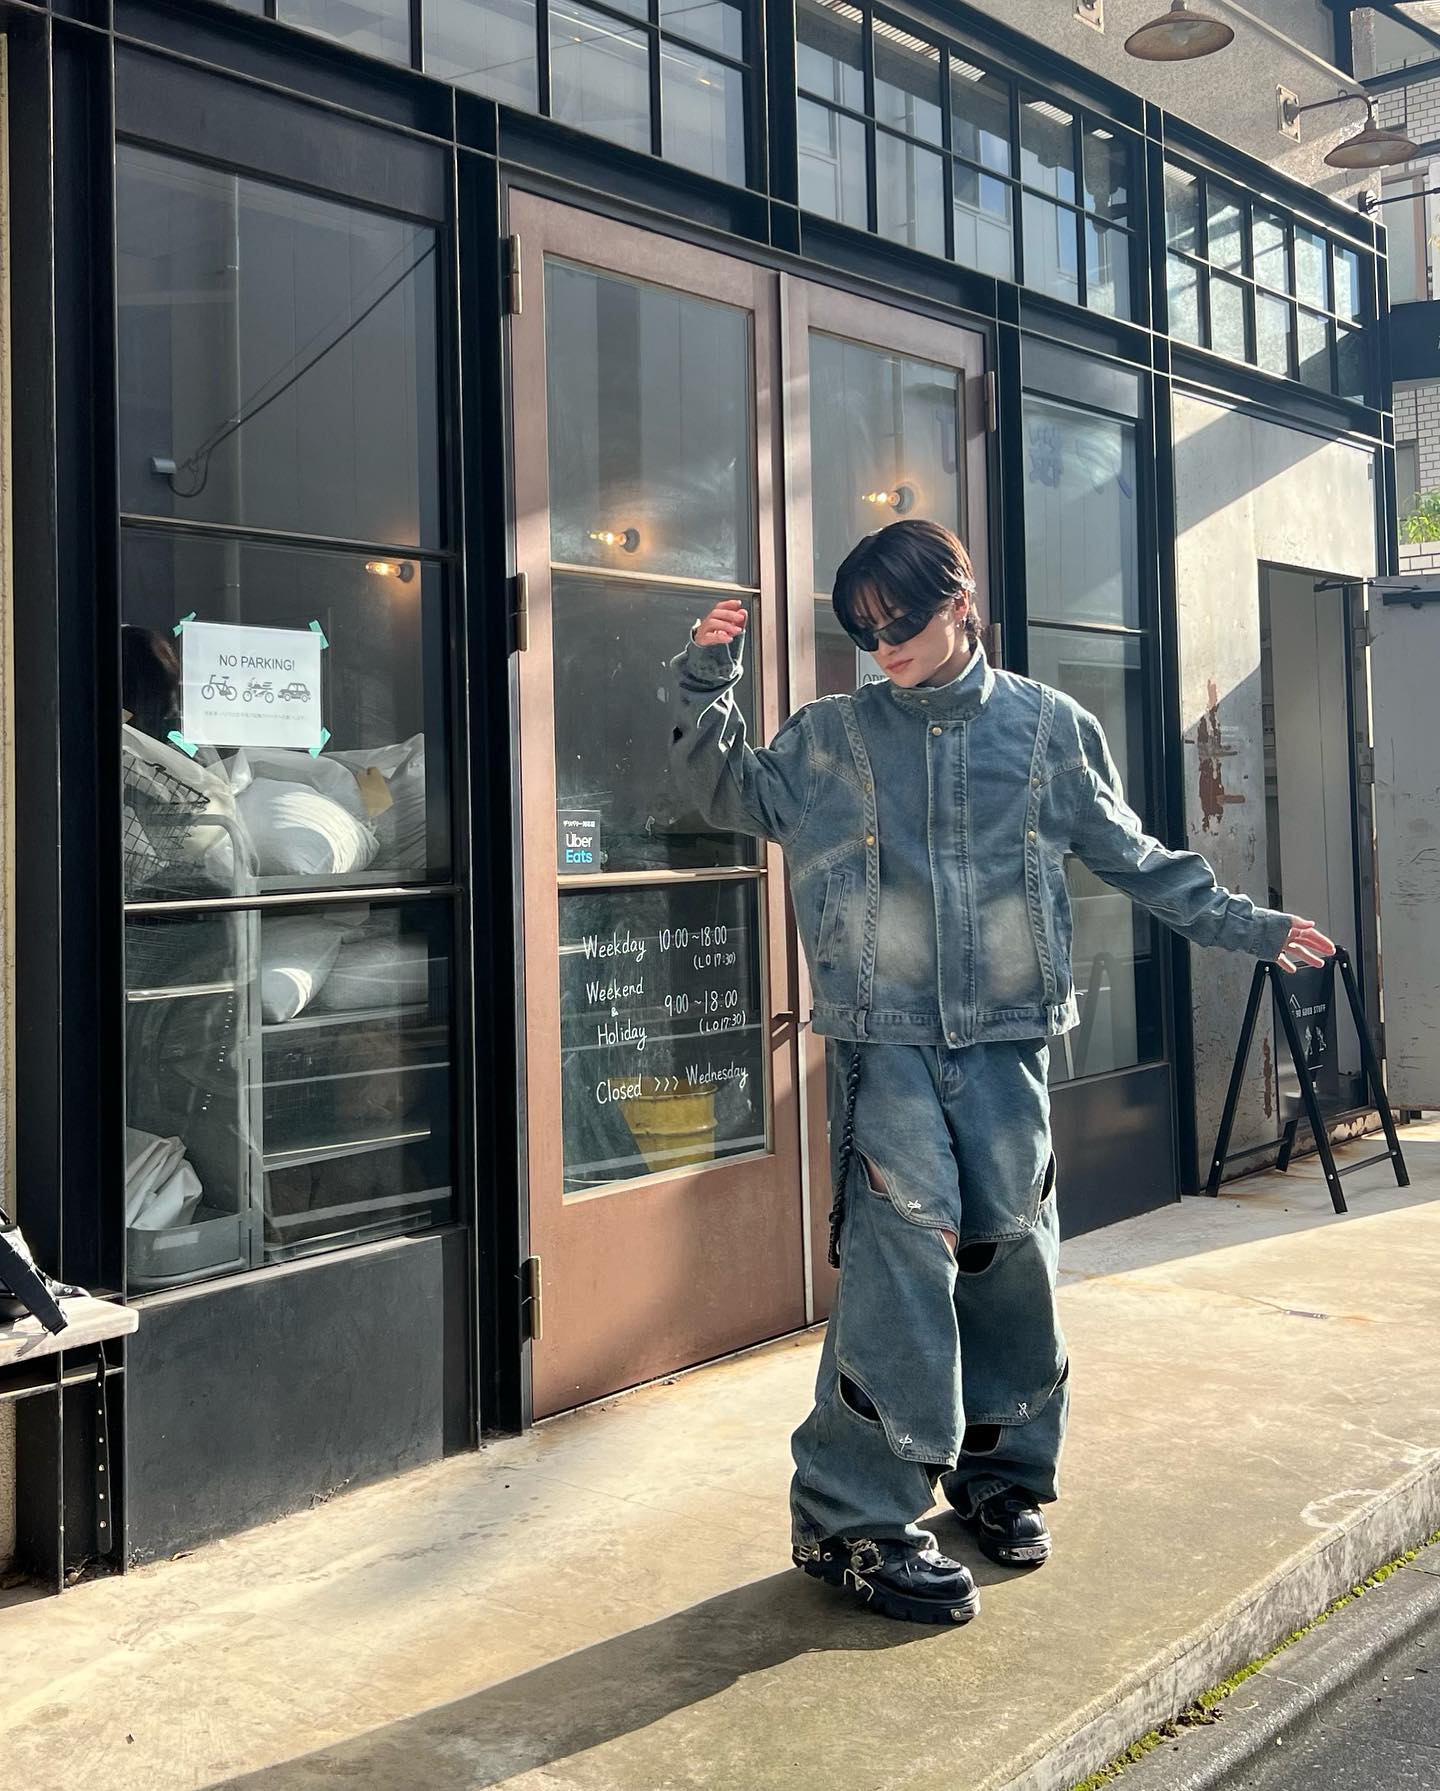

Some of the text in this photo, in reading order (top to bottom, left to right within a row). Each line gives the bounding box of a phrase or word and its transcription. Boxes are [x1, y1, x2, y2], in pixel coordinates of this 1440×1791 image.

[219, 654, 295, 670] NO PARKING!
[565, 833, 593, 848] Uber
[565, 849, 593, 864] Eats
[582, 930, 647, 962] Weekday
[586, 976, 644, 1004] Weekend
[611, 1006, 620, 1017] &
[597, 1019, 648, 1050] Holiday
[596, 1074, 643, 1104] Closed
[685, 1062, 749, 1089] Wednesday
